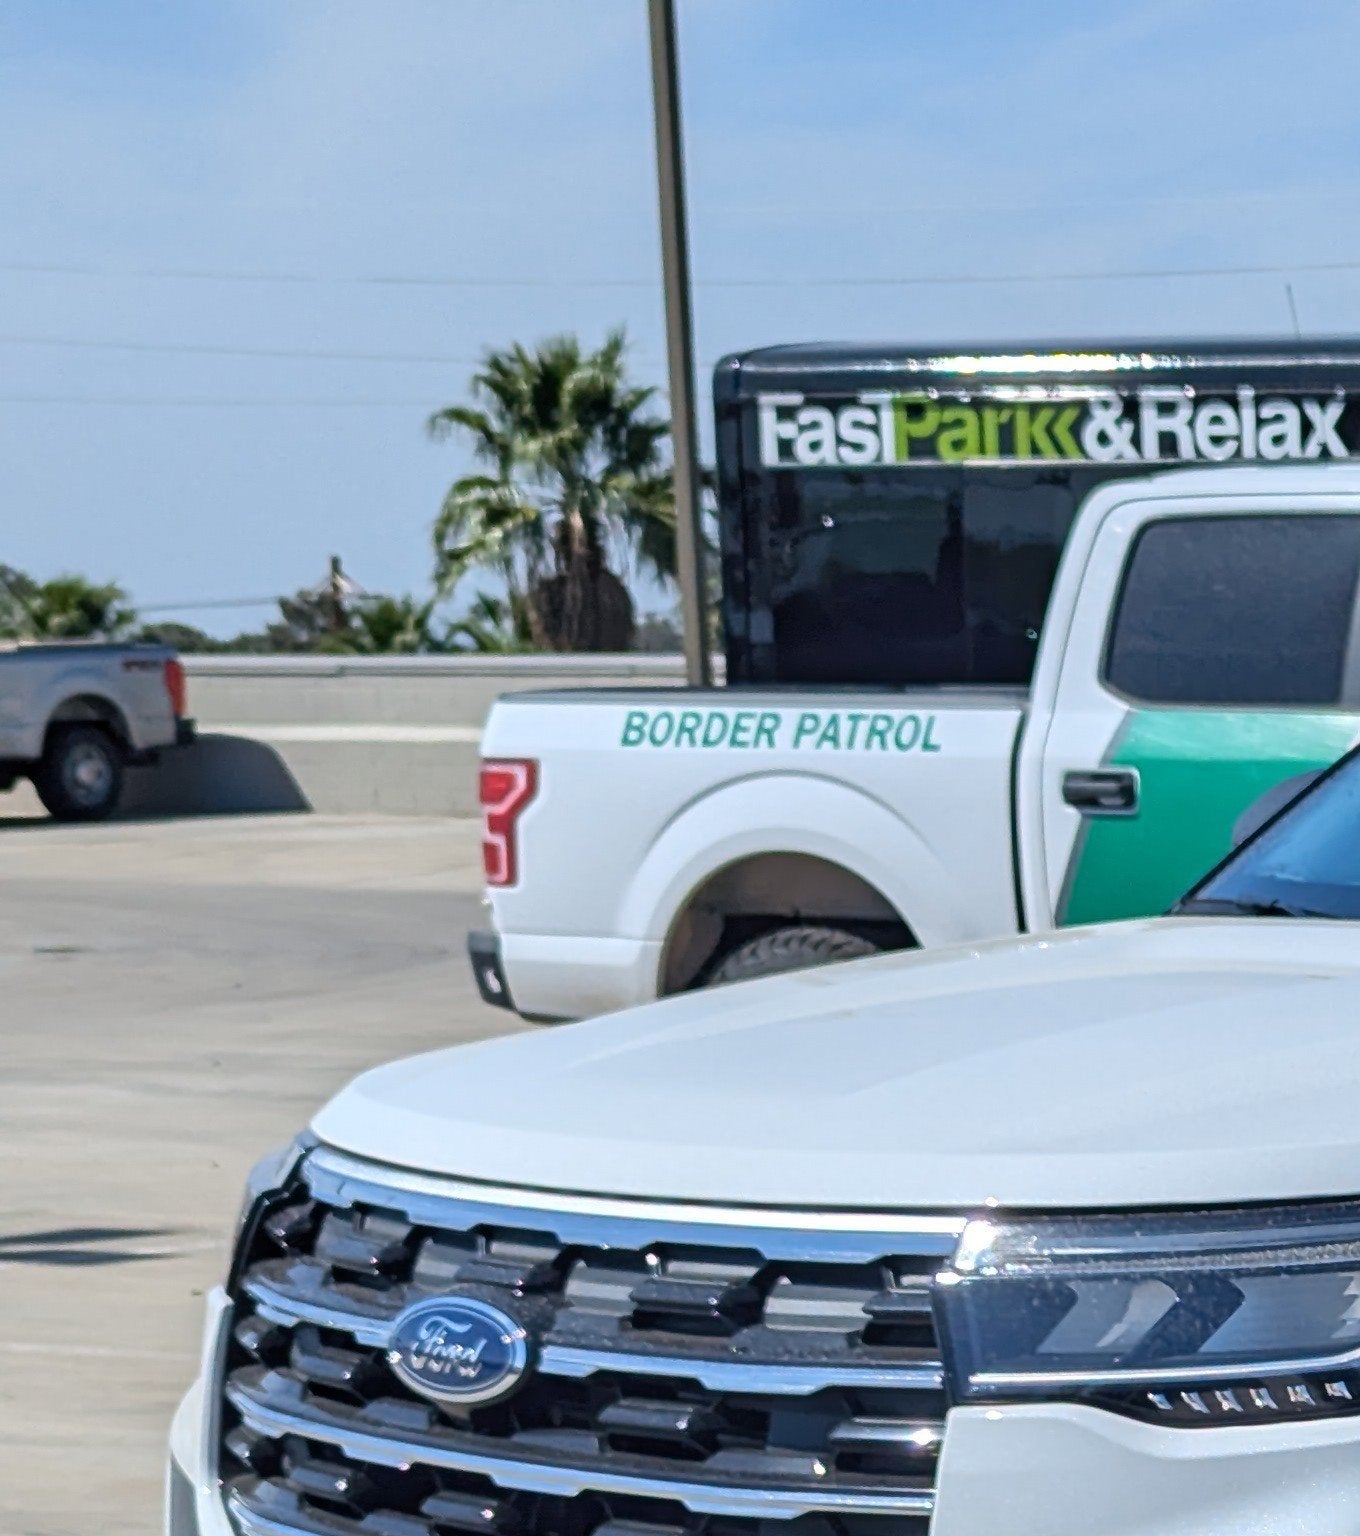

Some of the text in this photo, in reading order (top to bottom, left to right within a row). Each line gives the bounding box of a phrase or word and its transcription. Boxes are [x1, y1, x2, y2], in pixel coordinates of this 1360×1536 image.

[620, 710, 941, 752] BORDER PATROL
[414, 1316, 487, 1370] Ford
